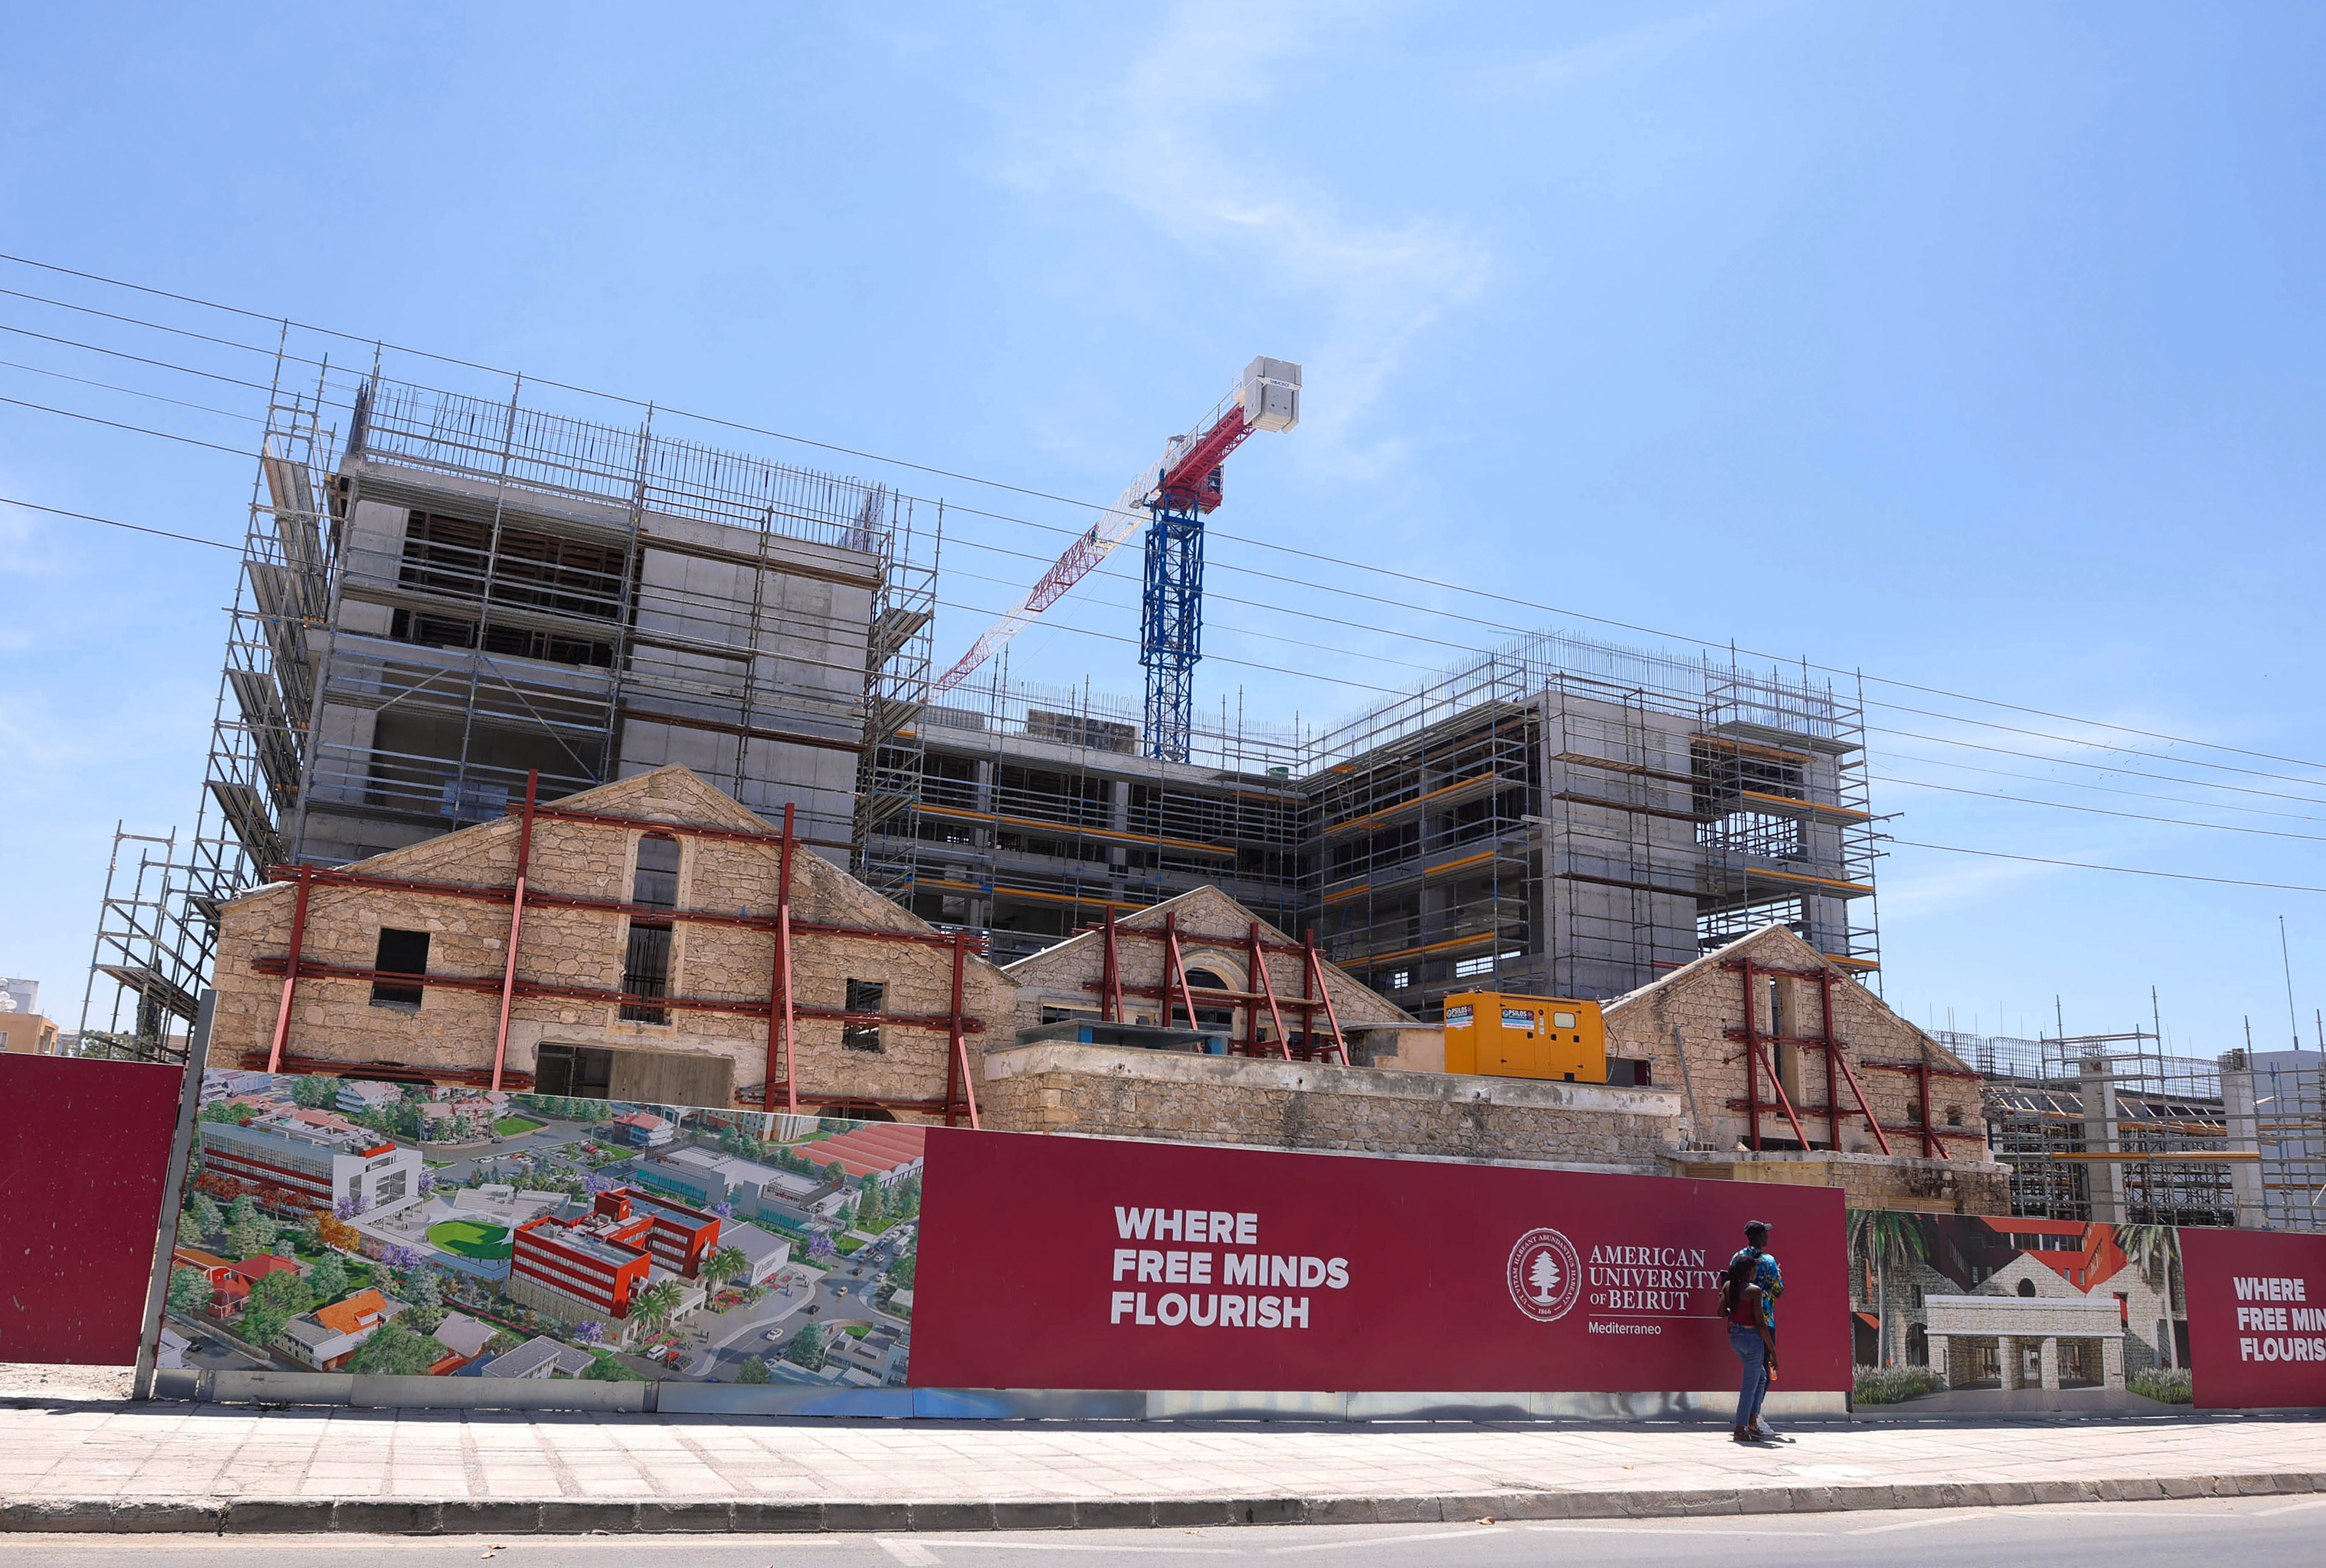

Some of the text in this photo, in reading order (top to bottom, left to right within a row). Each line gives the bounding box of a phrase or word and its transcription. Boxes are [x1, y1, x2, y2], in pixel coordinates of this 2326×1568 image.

[1114, 1206, 1258, 1245] WHERE
[1588, 1245, 1706, 1267] AMERICAN
[1113, 1248, 1349, 1289] FREE MINDS
[1588, 1267, 1721, 1289] UNIVERSITY
[1590, 1289, 1689, 1310] OF BEIRUT
[2233, 1277, 2306, 1301] WHERE
[1111, 1291, 1309, 1328] FLOURISH
[2237, 1307, 2288, 1331] FREE
[1589, 1321, 1661, 1335] Mediterraneo
[2240, 1338, 2326, 1361] FLOURIS
